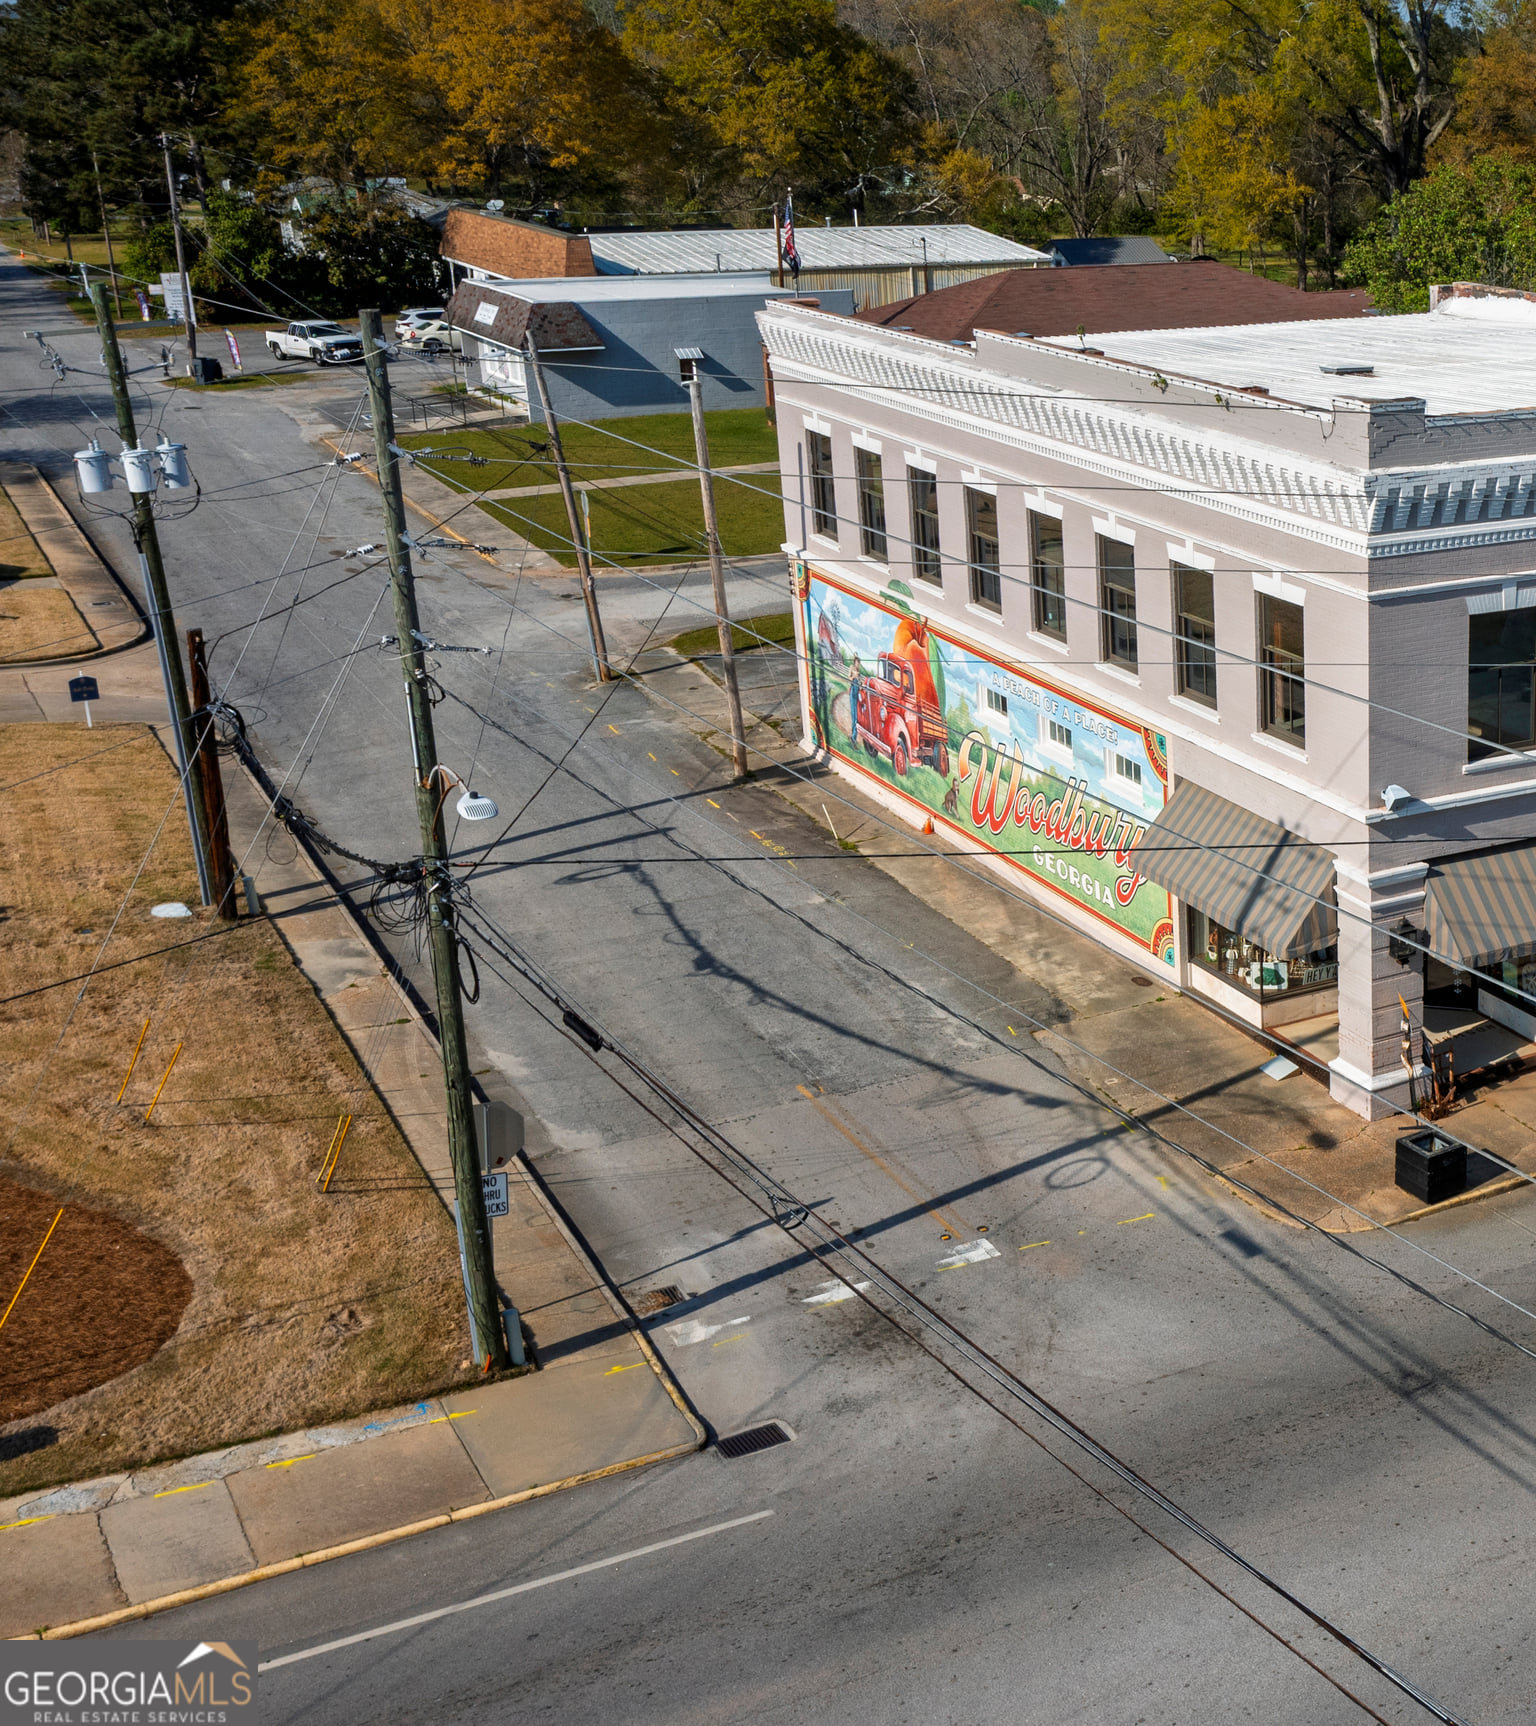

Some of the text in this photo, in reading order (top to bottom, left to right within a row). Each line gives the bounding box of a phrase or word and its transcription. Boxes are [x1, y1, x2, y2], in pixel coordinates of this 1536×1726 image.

[992, 671, 1119, 745] A PEACH OF A PLACE!
[958, 730, 1148, 907] Woodbury
[1032, 844, 1116, 910] GEORGIA
[1306, 968, 1324, 983] HEY
[483, 1176, 497, 1189] NO
[484, 1189, 501, 1201] HRU
[486, 1201, 507, 1215] UCKS
